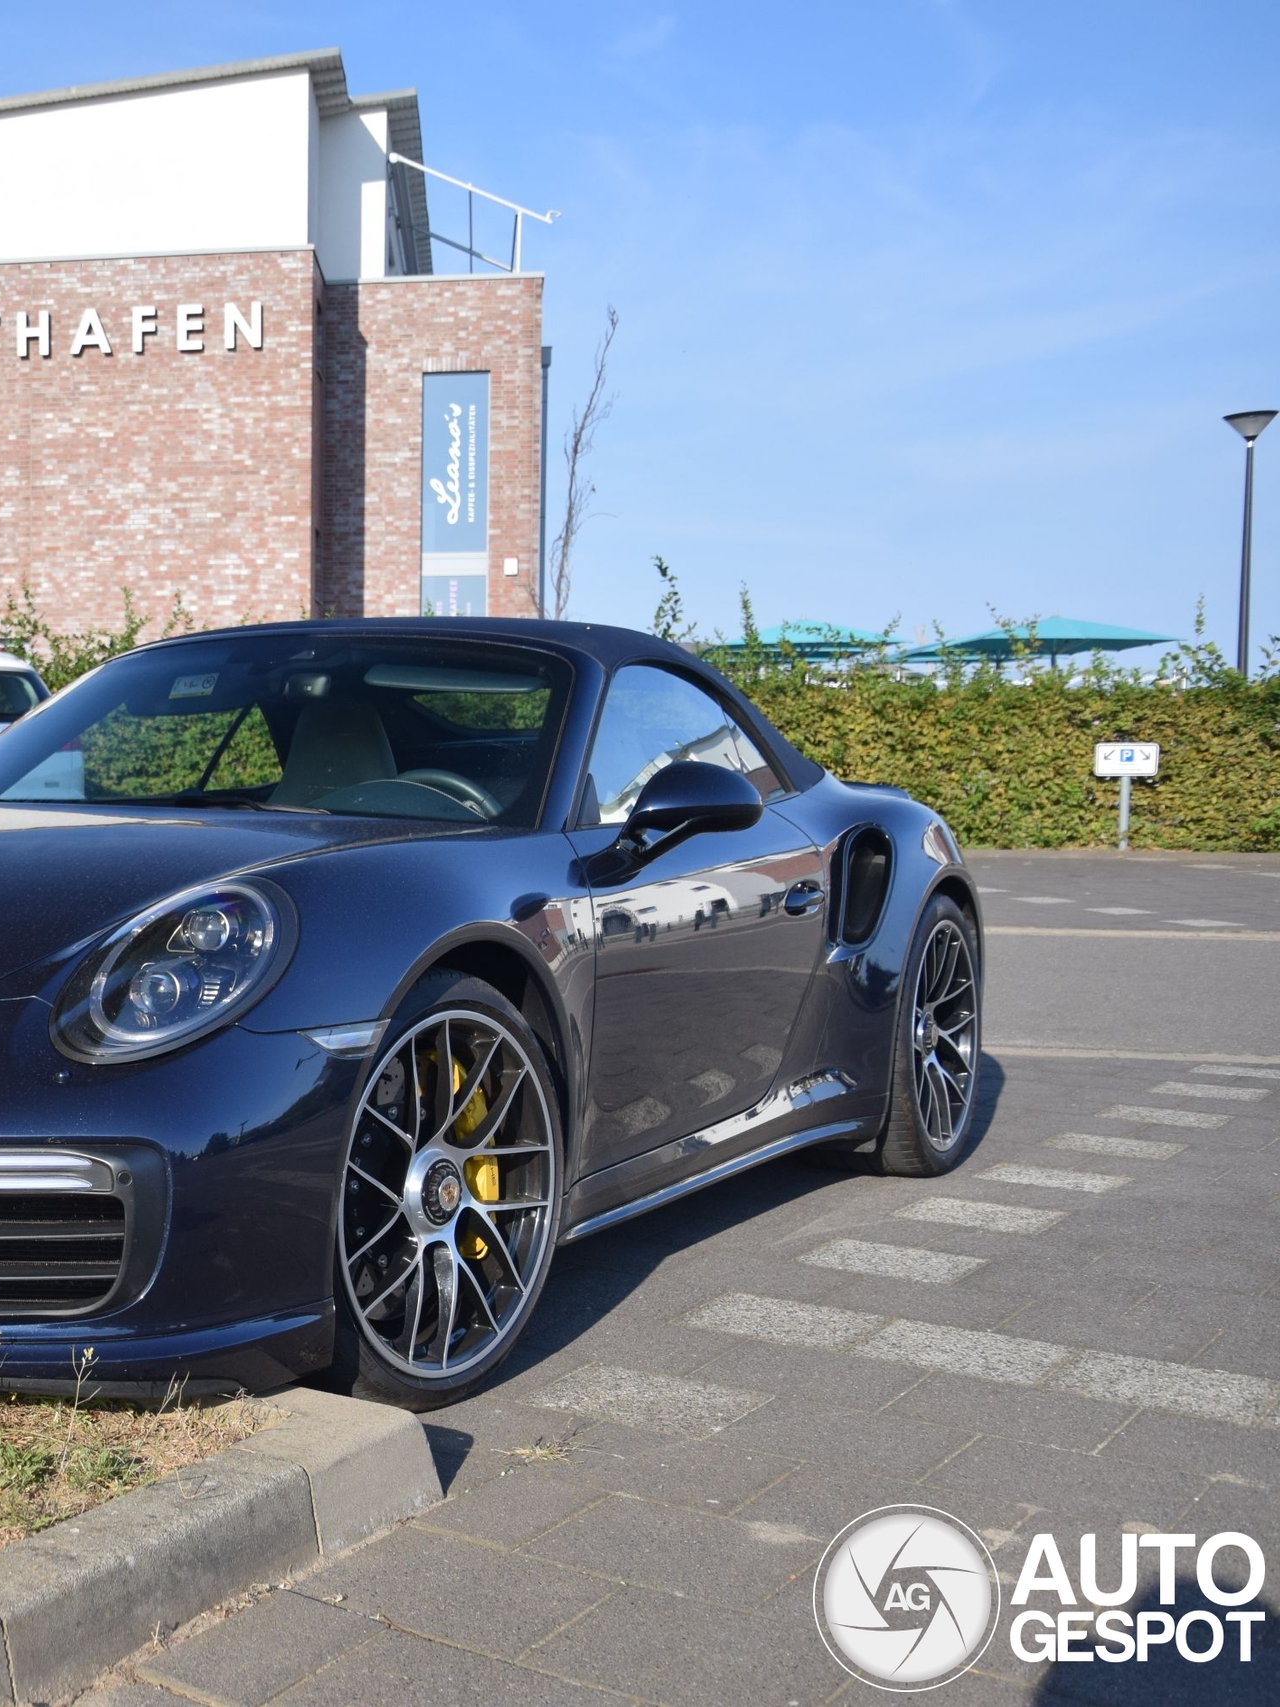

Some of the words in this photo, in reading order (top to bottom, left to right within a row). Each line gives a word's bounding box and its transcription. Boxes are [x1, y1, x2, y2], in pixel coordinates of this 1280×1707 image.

[429, 402, 462, 525] Leano's
[467, 404, 477, 480] EISSPEZIALITÄTEN
[467, 490, 476, 523] KAFFEE-
